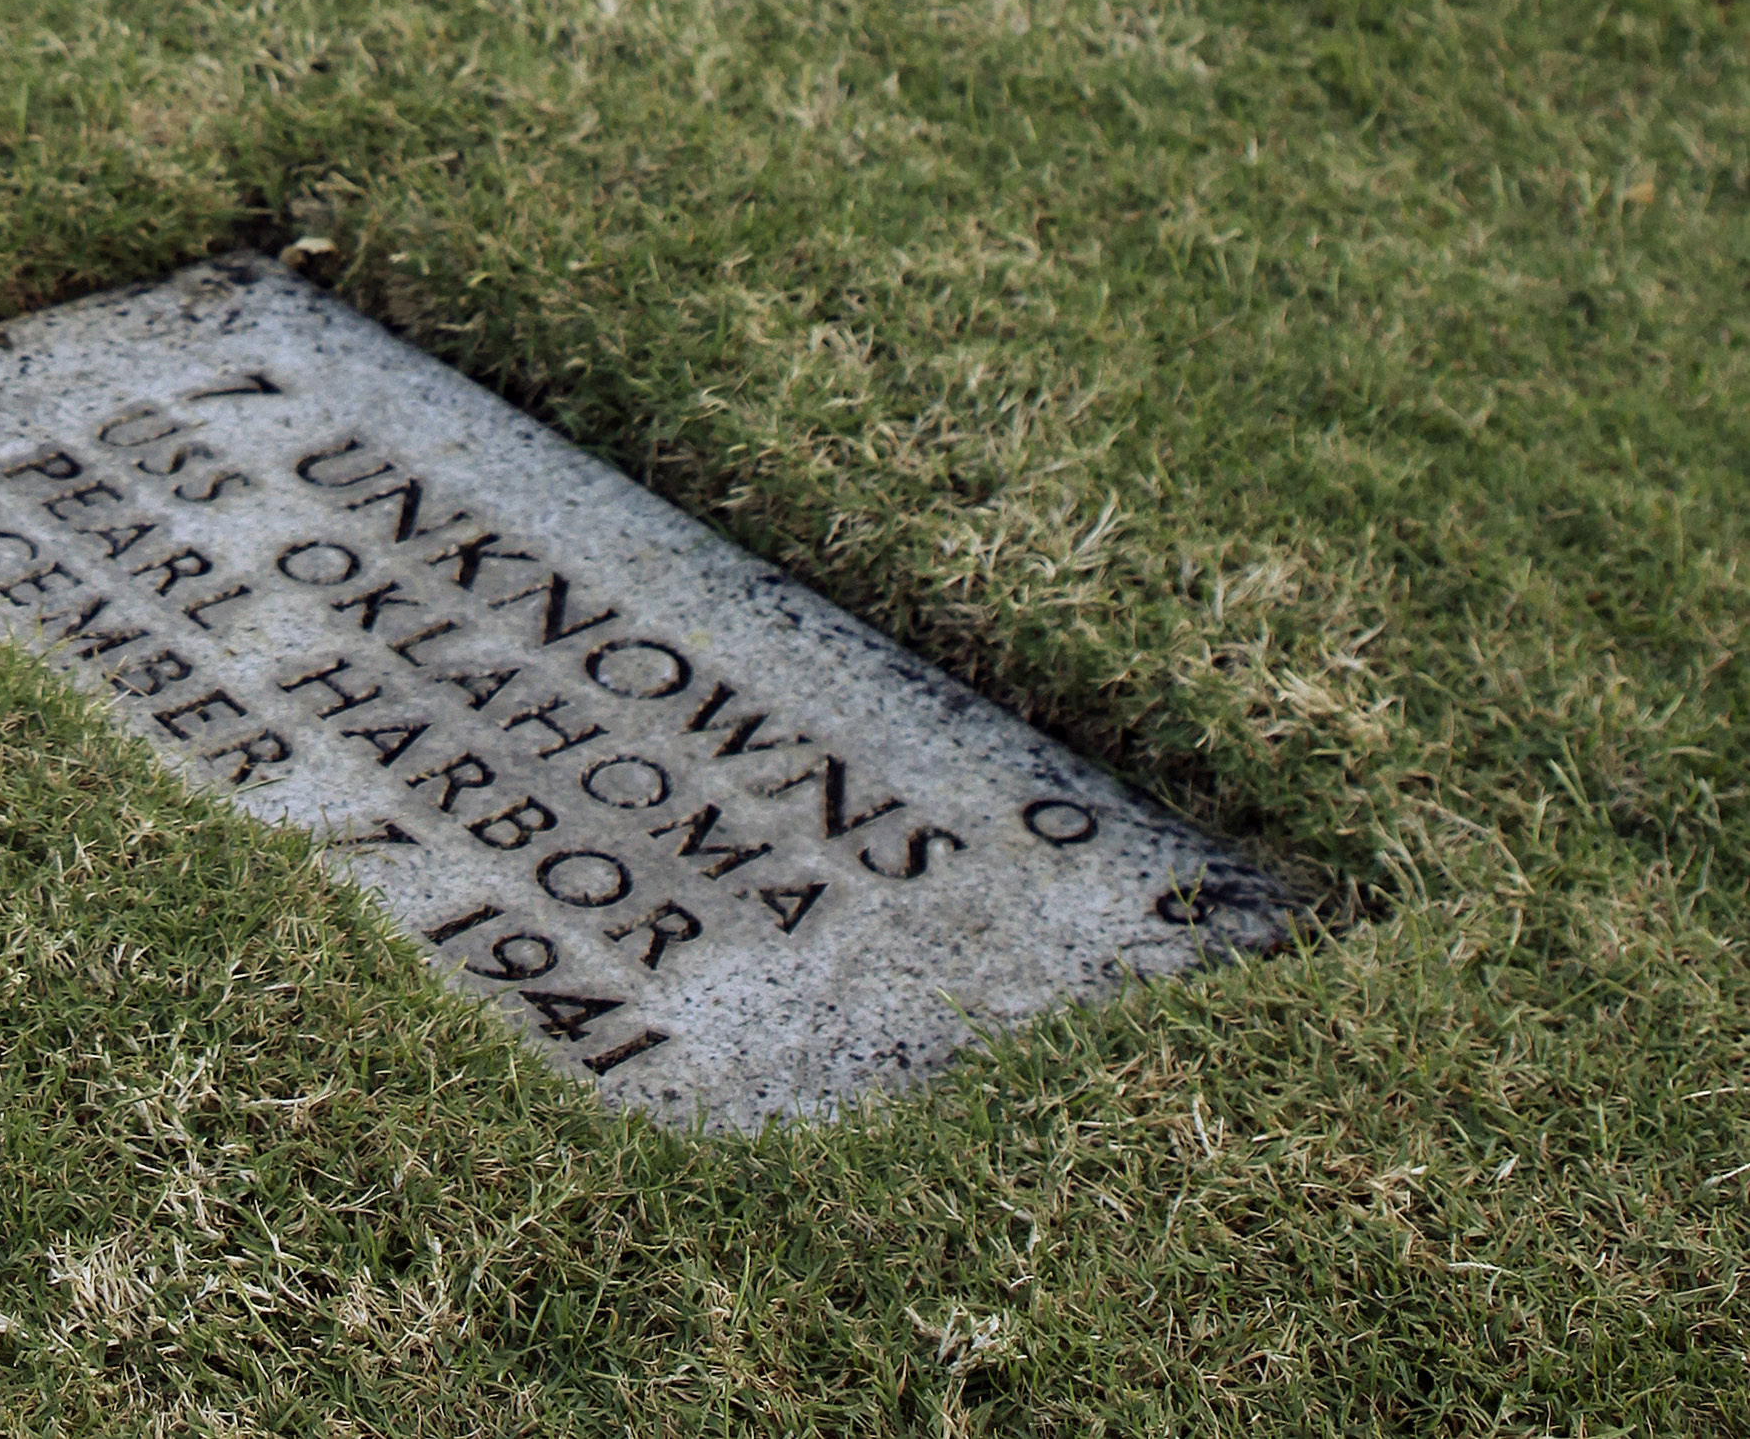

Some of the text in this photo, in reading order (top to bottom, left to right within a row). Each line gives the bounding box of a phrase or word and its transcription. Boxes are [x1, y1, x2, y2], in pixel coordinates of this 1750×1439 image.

[2, 450, 704, 971] PEARL HARBOR
[98, 407, 830, 936] USS OKLAHOMA
[188, 371, 969, 880] 7 UNKNOWNS
[330, 817, 421, 849] 7
[422, 903, 671, 1078] 1941
